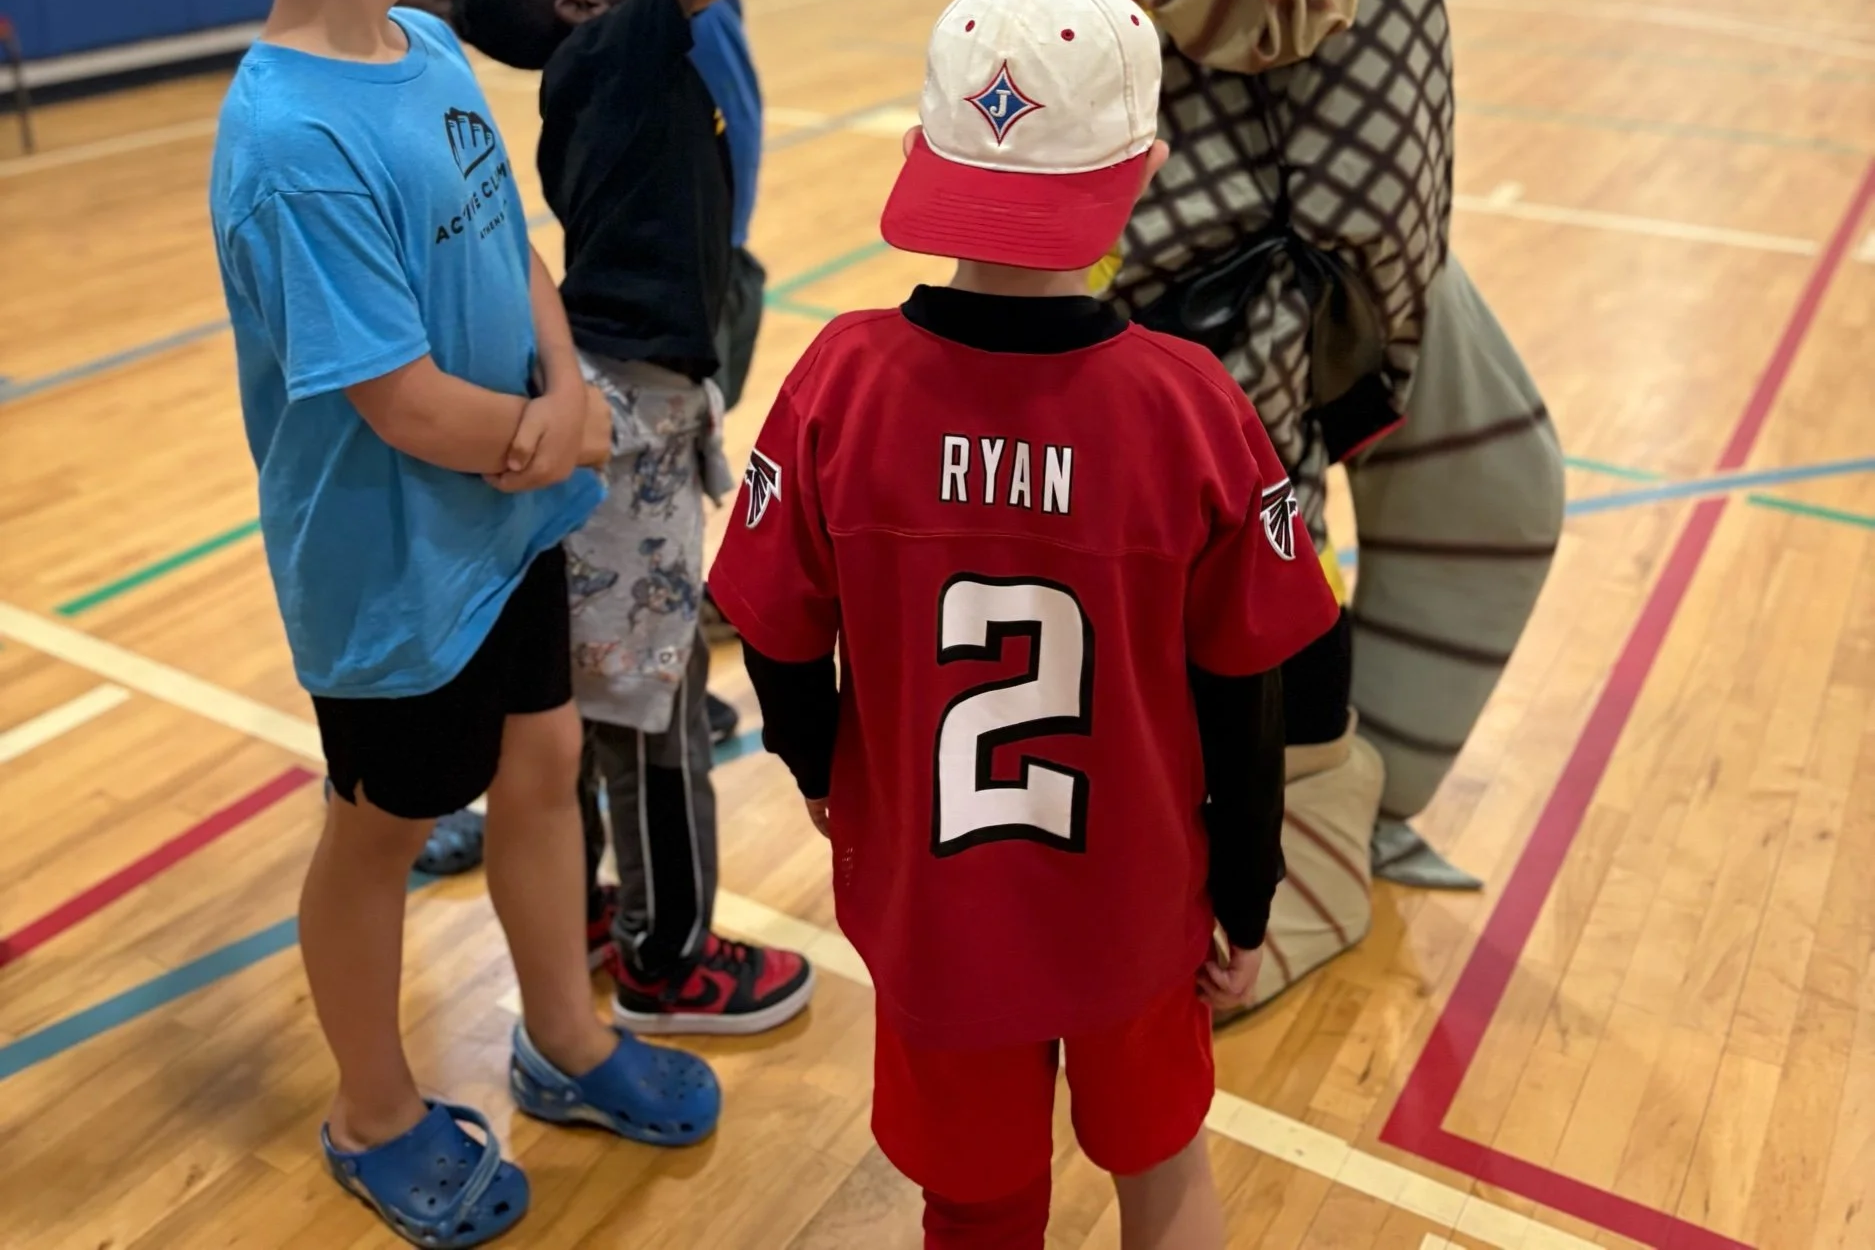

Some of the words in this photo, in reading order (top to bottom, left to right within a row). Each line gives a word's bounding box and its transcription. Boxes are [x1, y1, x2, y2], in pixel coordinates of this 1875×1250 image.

[989, 89, 1011, 117] J
[940, 433, 1072, 516] RYAN
[930, 571, 1095, 857] 2
